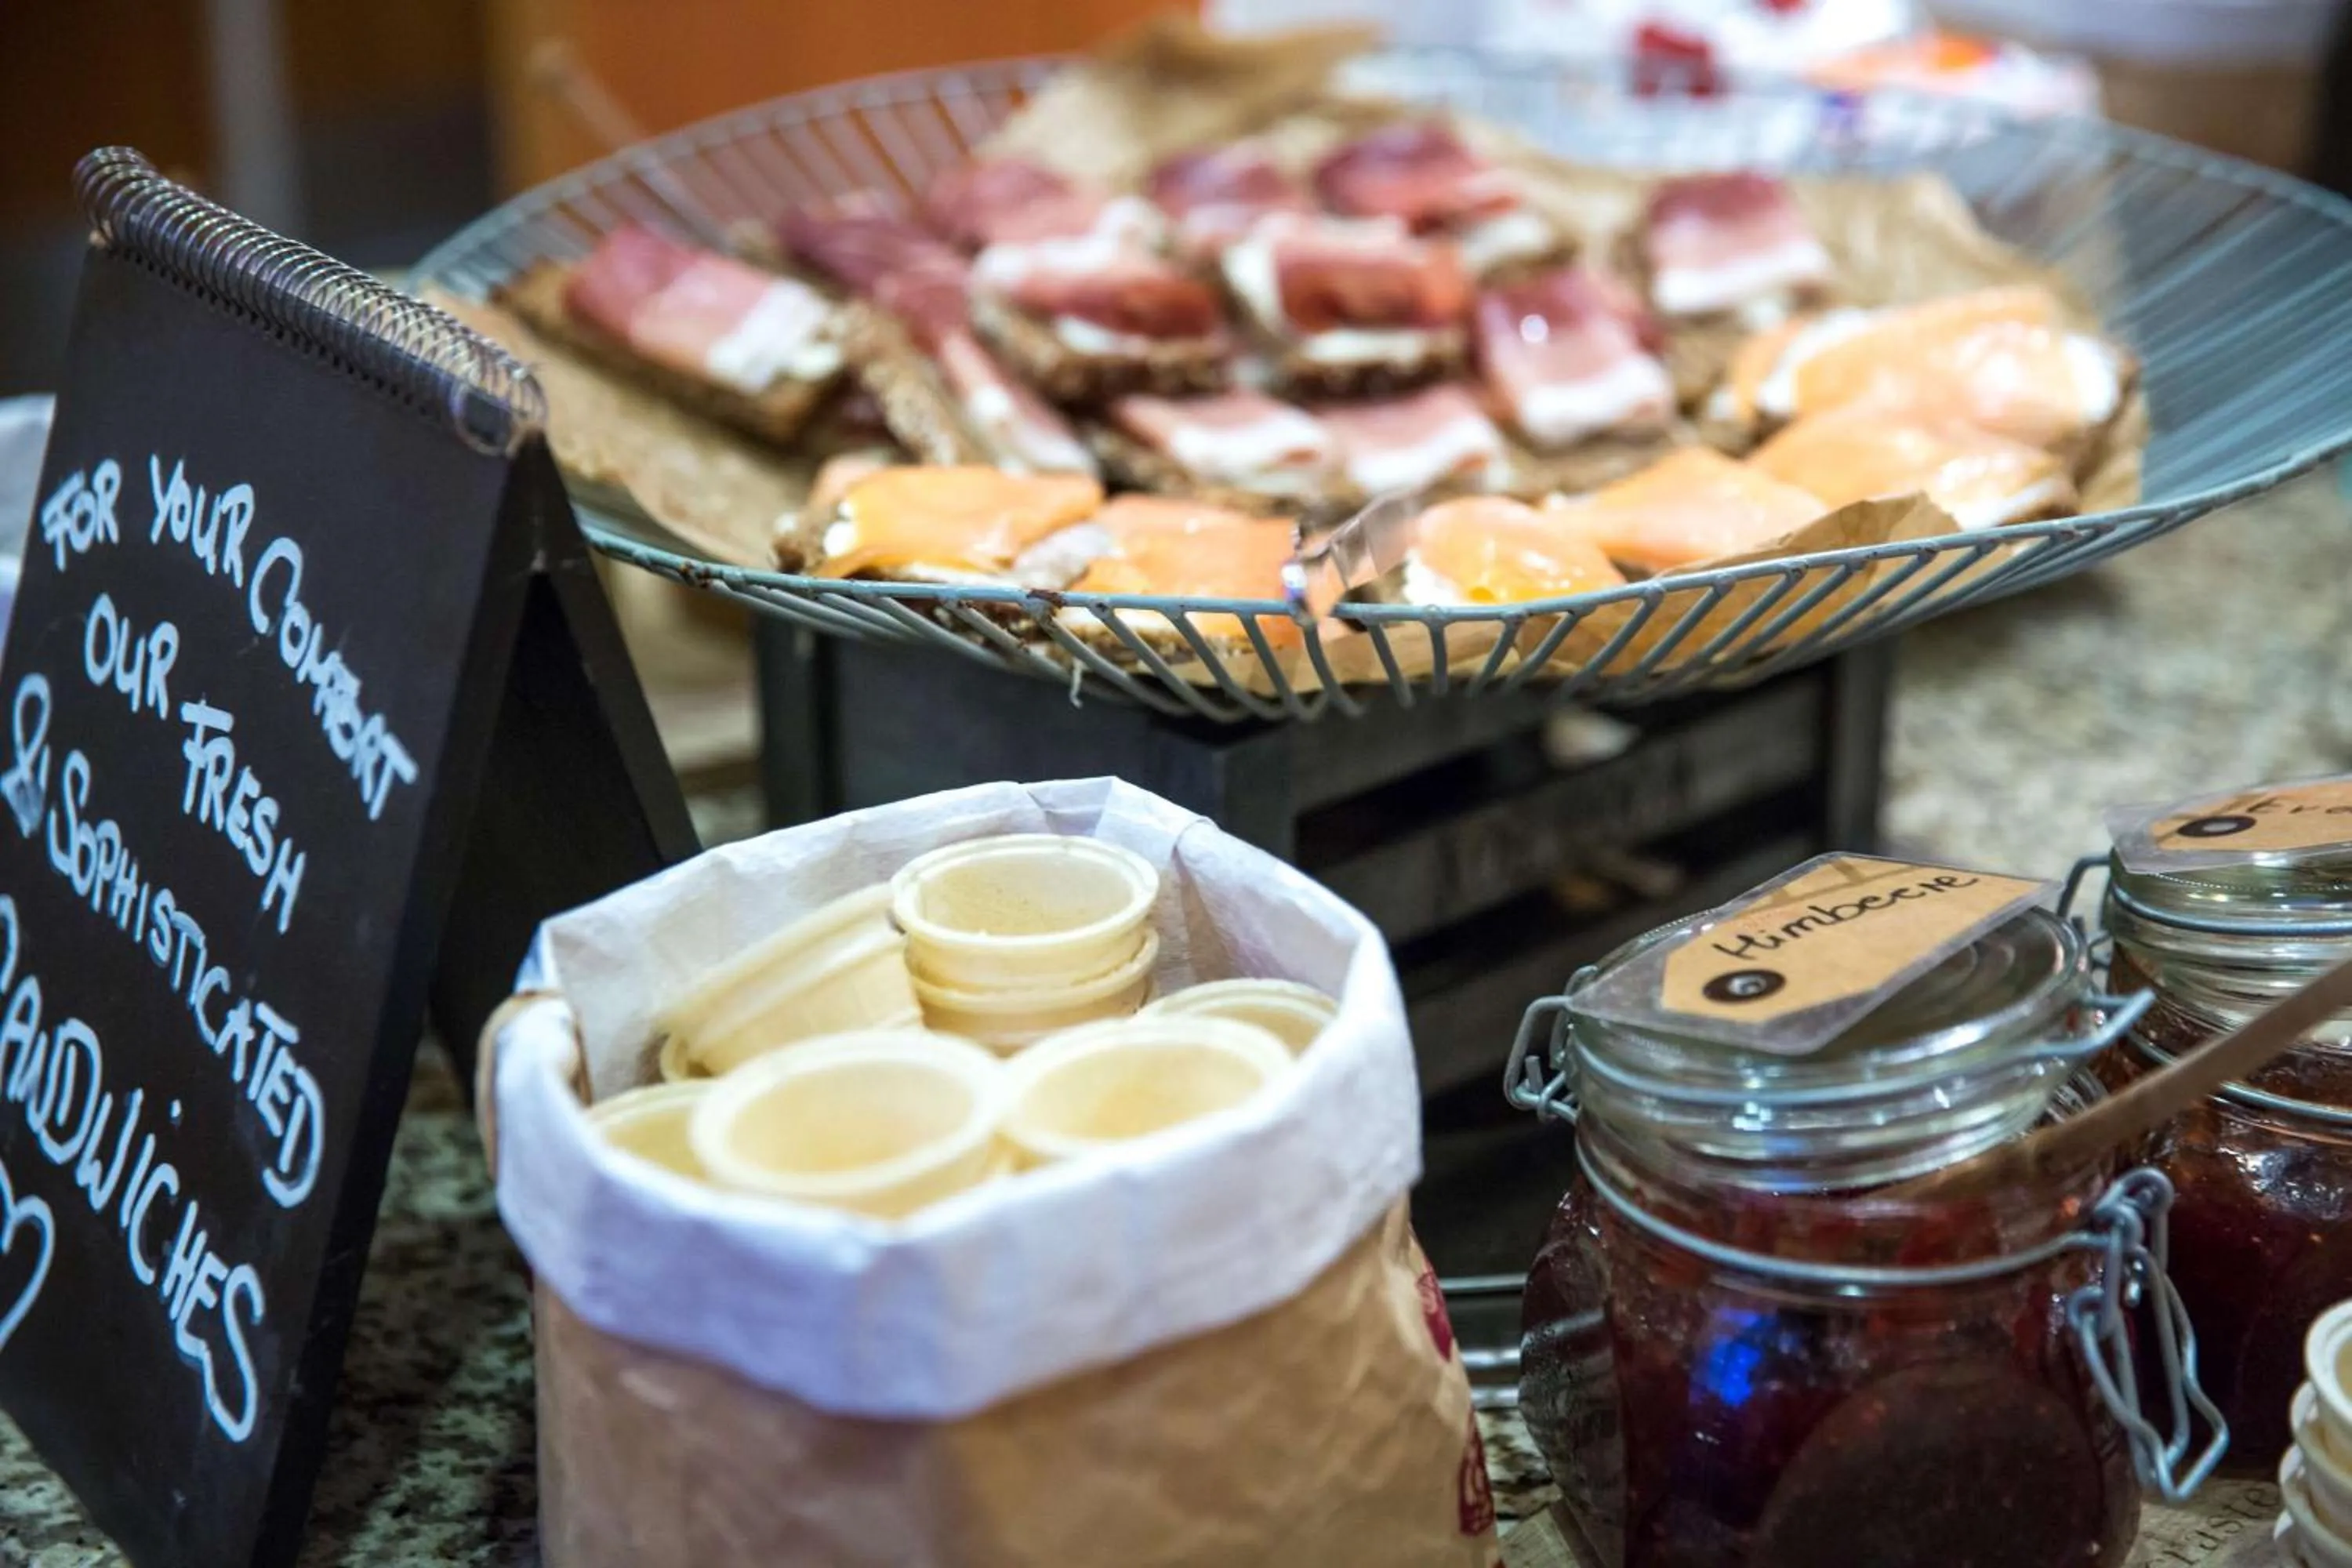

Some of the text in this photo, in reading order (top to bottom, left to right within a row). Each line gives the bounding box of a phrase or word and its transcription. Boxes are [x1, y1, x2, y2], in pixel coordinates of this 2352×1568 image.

[41, 454, 419, 821] FOR YOUR COMFORT
[84, 593, 306, 934] OUR FRESH
[48, 750, 325, 1208] SOPHISTICATED
